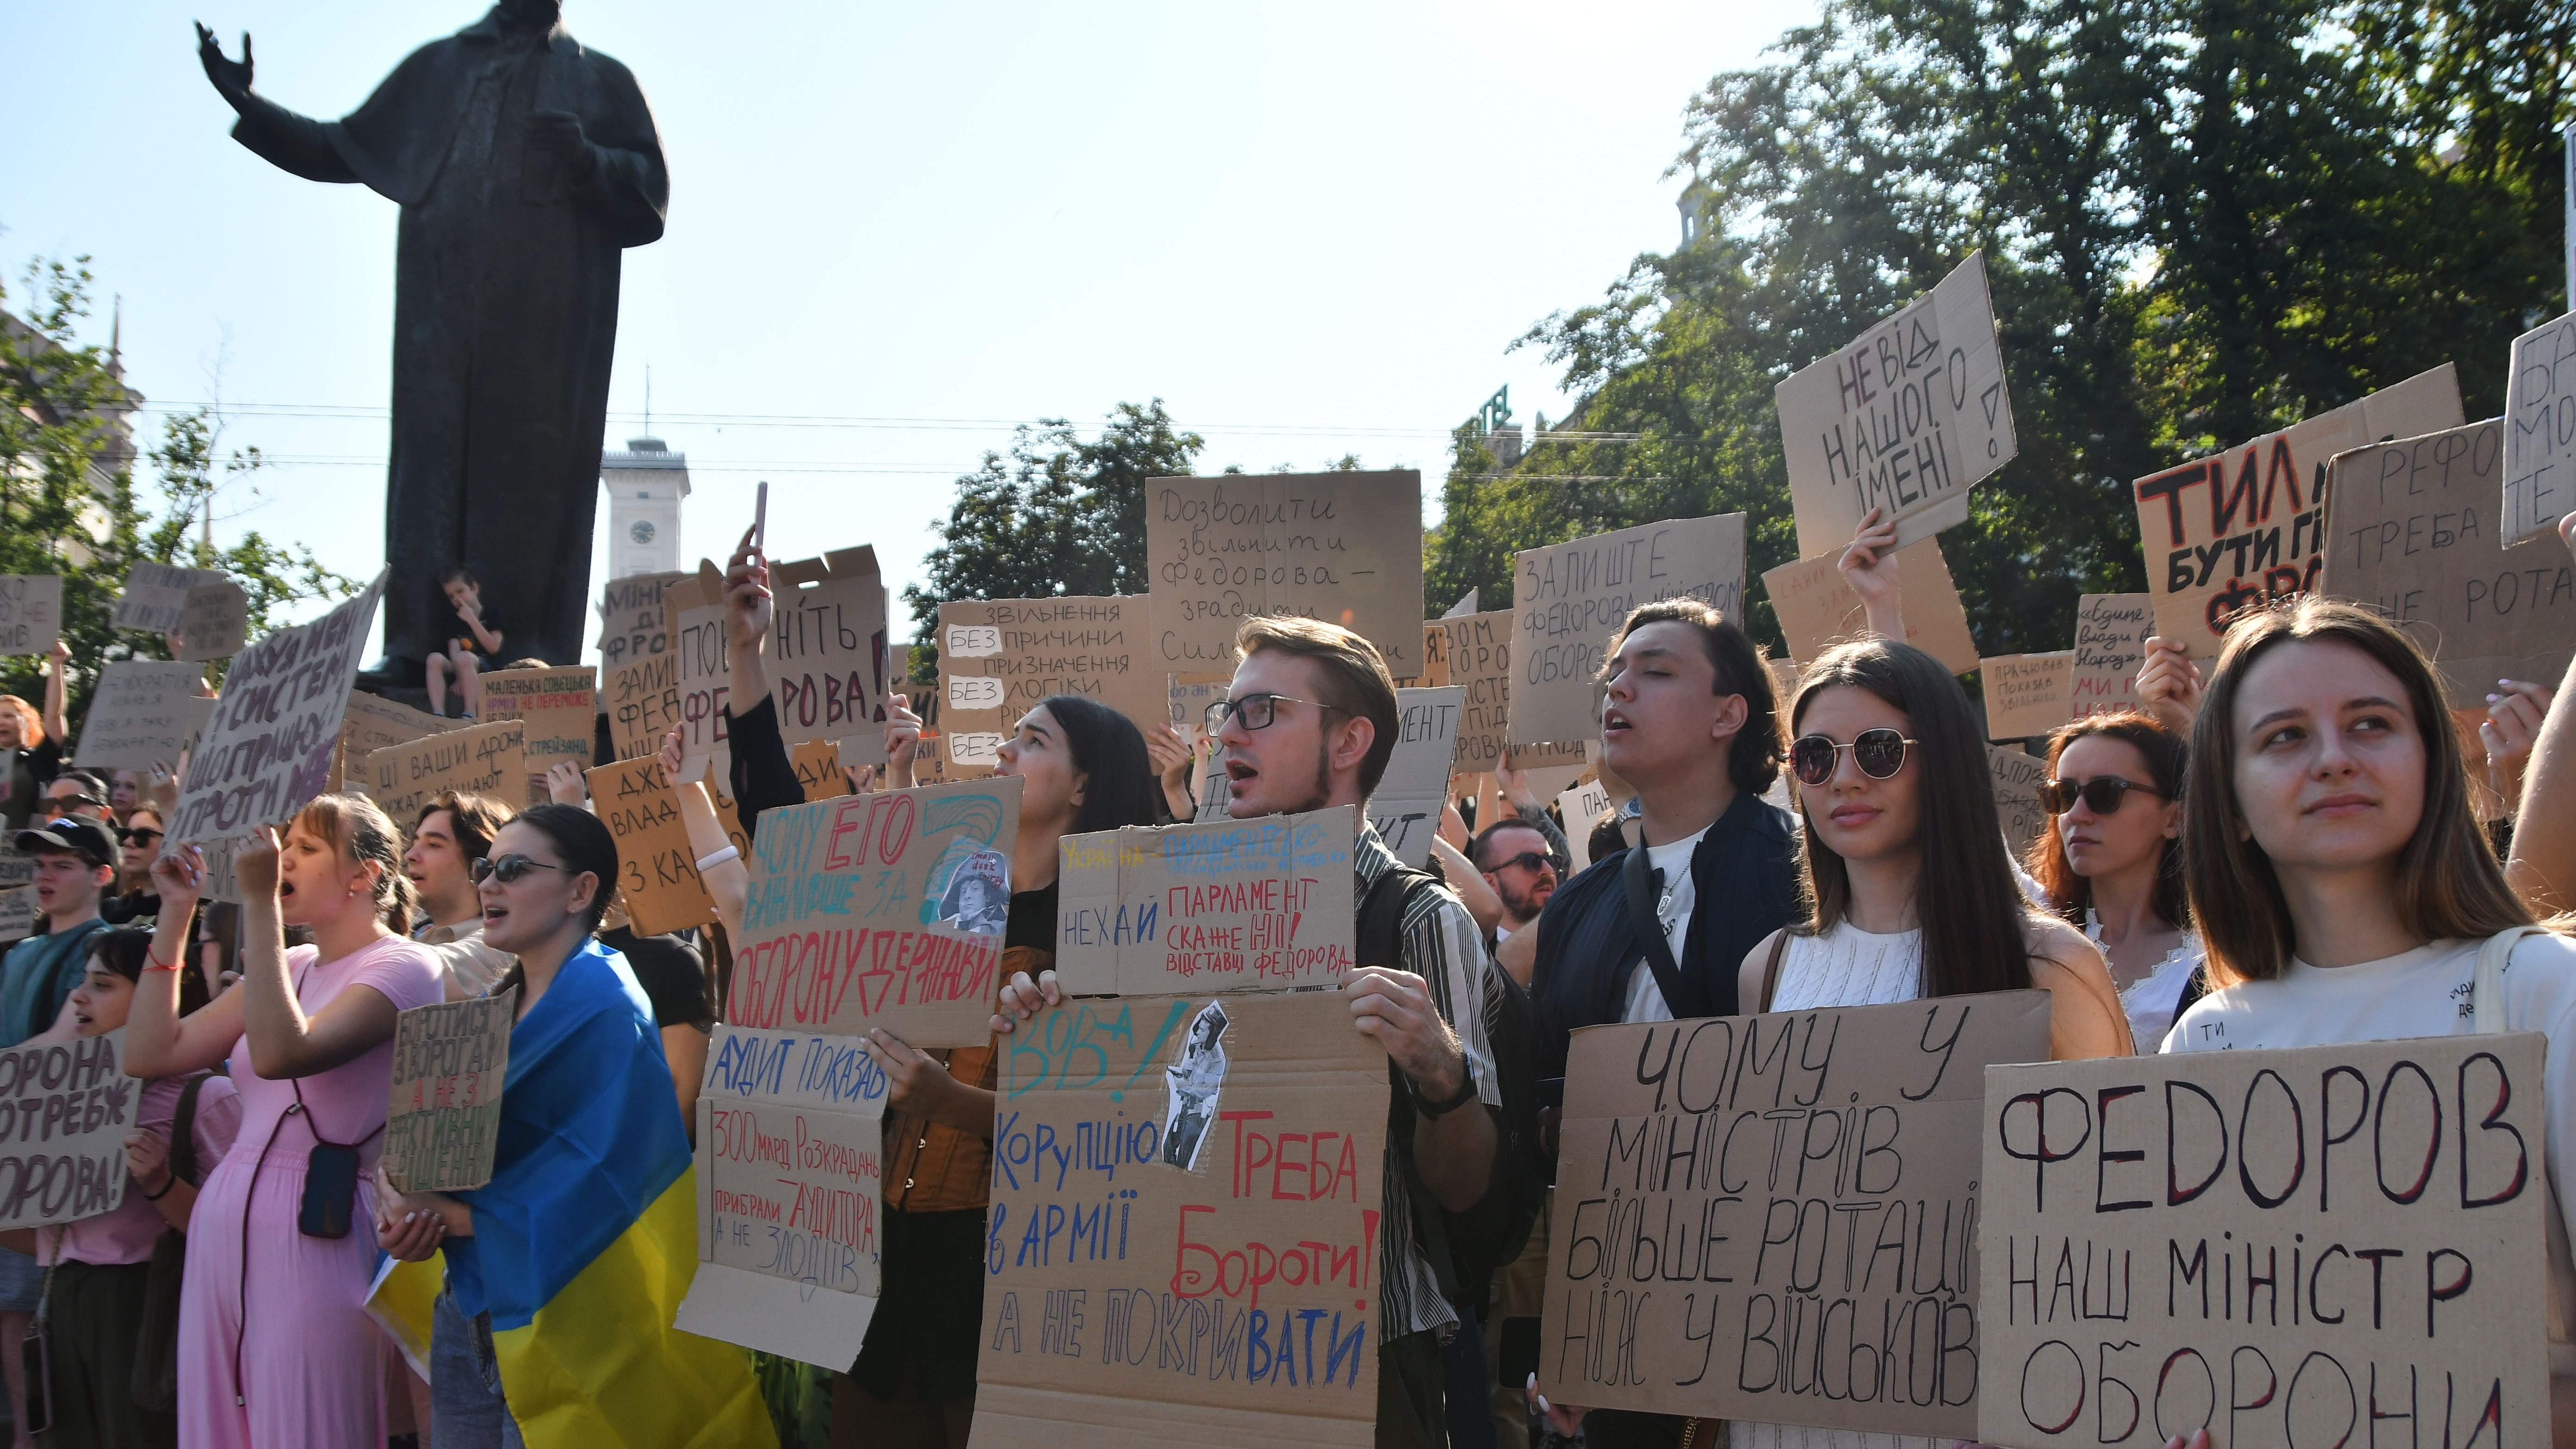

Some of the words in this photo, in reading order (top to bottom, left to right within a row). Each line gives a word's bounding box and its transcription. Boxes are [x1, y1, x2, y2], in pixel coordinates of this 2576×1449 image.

[1838, 346, 1877, 414] НЕ
[1877, 317, 1939, 388] ВІД
[1823, 347, 1966, 486] НАШОГО
[1856, 422, 1951, 517] ІМЕНІ
[2137, 435, 2302, 548] ТИЛ
[1160, 485, 1335, 530] Дозволити
[2350, 508, 2479, 569] ТРЕБА
[1178, 530, 1345, 561] звільнити
[1526, 530, 1670, 601] ЗАЛИШТЕ
[2167, 526, 2280, 594] БУТИ
[951, 630, 996, 649] БЕЗ
[1005, 630, 1123, 651] ПРИЧИНИ
[984, 604, 1120, 625] ЗВІЛЬНЕННЯ
[486, 679, 540, 695] МАЛЕНЬКА
[684, 628, 887, 745] ФЕРОВА!
[951, 682, 997, 700] БЕЗ
[1007, 677, 1102, 700] ЛОГІКИ
[984, 655, 1129, 675] ПРИЗНАЧЕННЯ
[1995, 659, 2063, 680] ПРАЦЮВАВ
[1999, 677, 2053, 694] ПОКАЗАВ
[2074, 677, 2111, 696] МИ
[487, 697, 516, 712] АРМІЯ
[521, 696, 533, 710] НЕ
[537, 692, 588, 709] ПЕРЕМОЖЕ
[380, 758, 397, 790] ЦІ
[411, 742, 467, 780] ВАШИ
[477, 730, 523, 774] ДРОНИ
[529, 736, 588, 756] СТРЕЙЗАНД
[952, 736, 998, 757] БЕЗ
[755, 805, 826, 874] ЧОМУ
[824, 794, 915, 871] ЕГО
[865, 871, 908, 918] ЗА
[1065, 895, 1158, 947] НЕХАЙ
[1168, 878, 1319, 917] ПАРЛАМЕНТ
[1166, 952, 1245, 978] ВІДСТАВЦІ
[1254, 944, 1353, 979] ФЕДОРОВА
[1167, 924, 1242, 951] СКАЖЕ
[1250, 911, 1302, 952] НІ!
[728, 928, 868, 1029] ОБОРОНУ
[393, 1046, 405, 1085] З
[708, 1034, 795, 1097] АУДИТ
[1007, 1001, 1190, 1104] ВОВА!
[1637, 1013, 1841, 1115] ЧОМУ
[1900, 1005, 1971, 1102] У
[412, 1078, 423, 1110] А
[435, 1074, 457, 1108] НЕ
[462, 1071, 479, 1108] З
[1602, 1092, 1903, 1198] МІНІСТРІВ
[2000, 1051, 2529, 1214] ФЕДОРОВ
[715, 1189, 781, 1224] ПРИБРАЛИ
[1016, 1189, 1138, 1268] АРМІЇ
[1566, 1187, 1744, 1283] БІЛЬШЕ
[715, 1217, 724, 1244] А
[732, 1224, 750, 1247] НЕ
[756, 1225, 859, 1303] ЗЛОДІЇВ
[2010, 1236, 2131, 1326] НАШ
[2168, 1230, 2473, 1338] МІНІСТР
[992, 1291, 1022, 1354] А
[1040, 1289, 1087, 1358] НЕ
[1103, 1288, 1366, 1389] ПОКРИВАТИ
[1558, 1280, 1651, 1387] НІЖ
[1674, 1293, 1718, 1386] У
[2021, 1339, 2502, 1449] ОБОРОНИ
